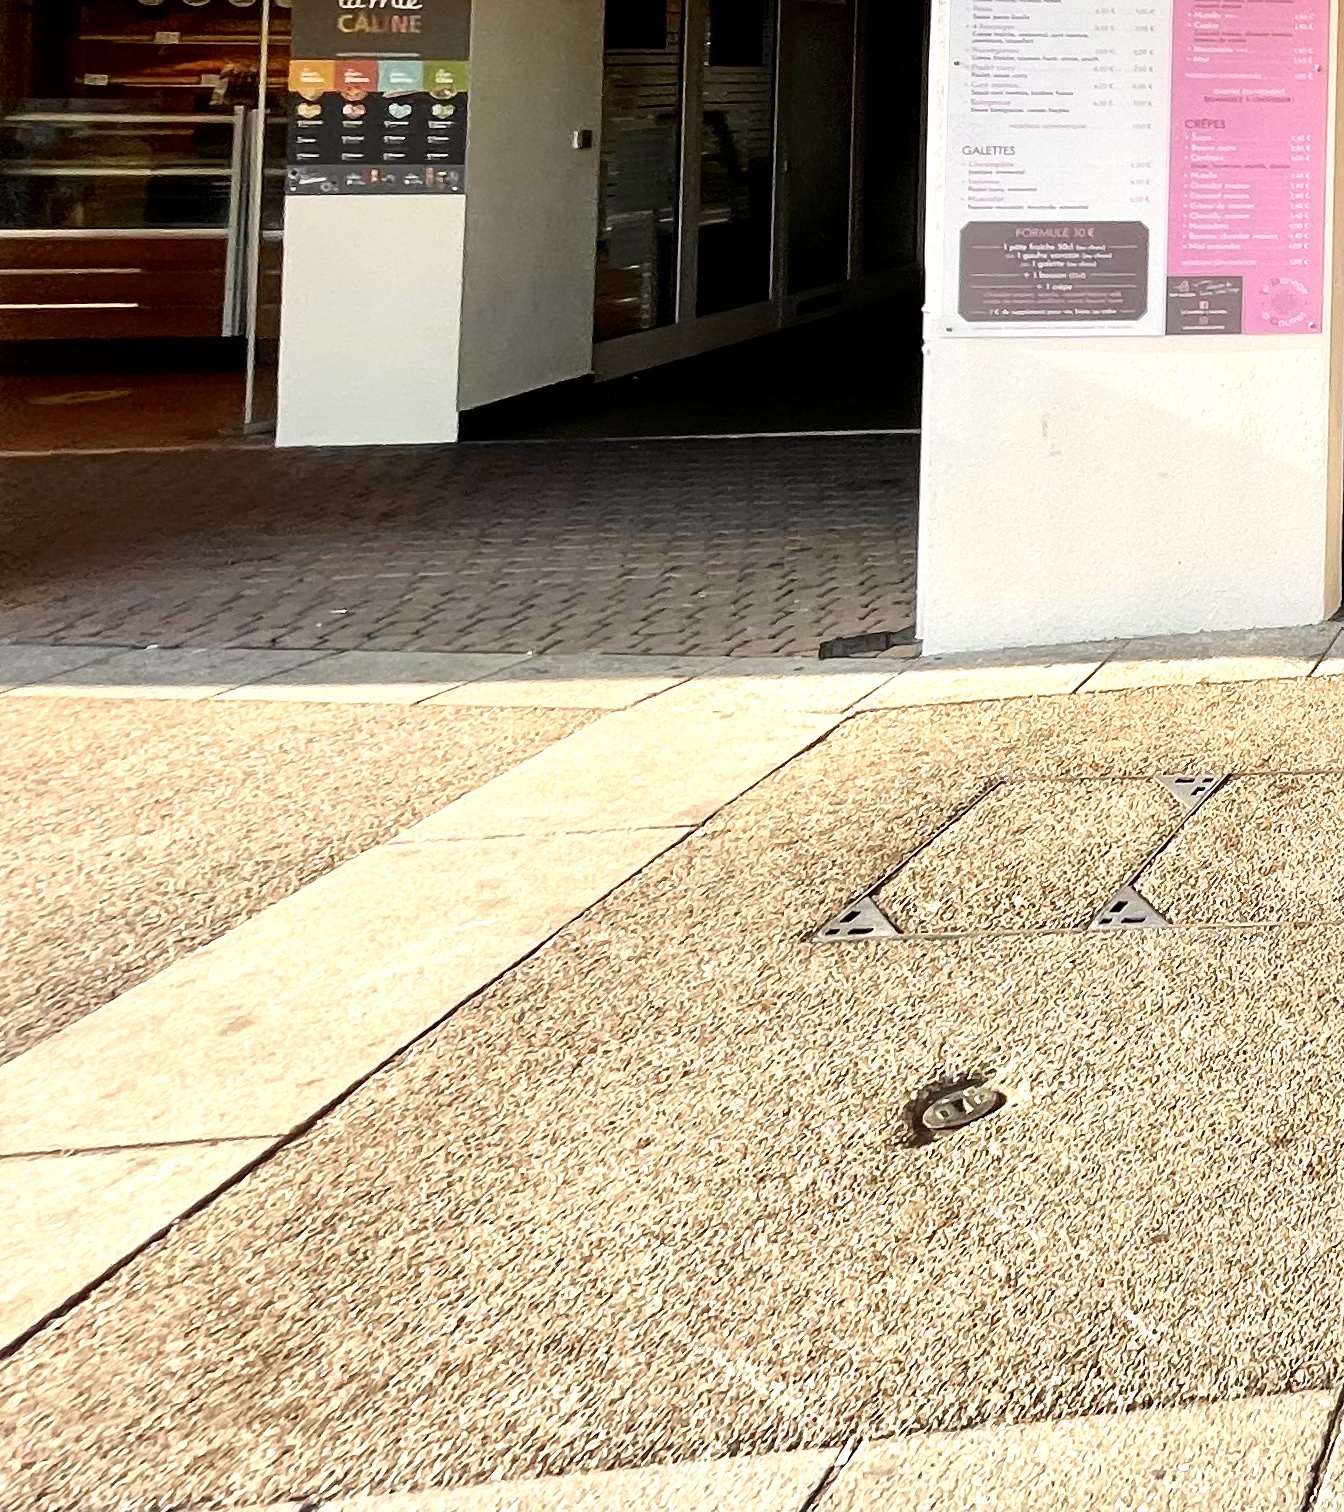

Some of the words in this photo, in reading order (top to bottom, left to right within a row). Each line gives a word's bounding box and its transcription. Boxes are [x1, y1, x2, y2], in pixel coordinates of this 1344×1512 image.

[1185, 118, 1226, 129] CRÊPES
[962, 145, 1016, 156] GALETTES
[1015, 227, 1070, 238] FORMULE
